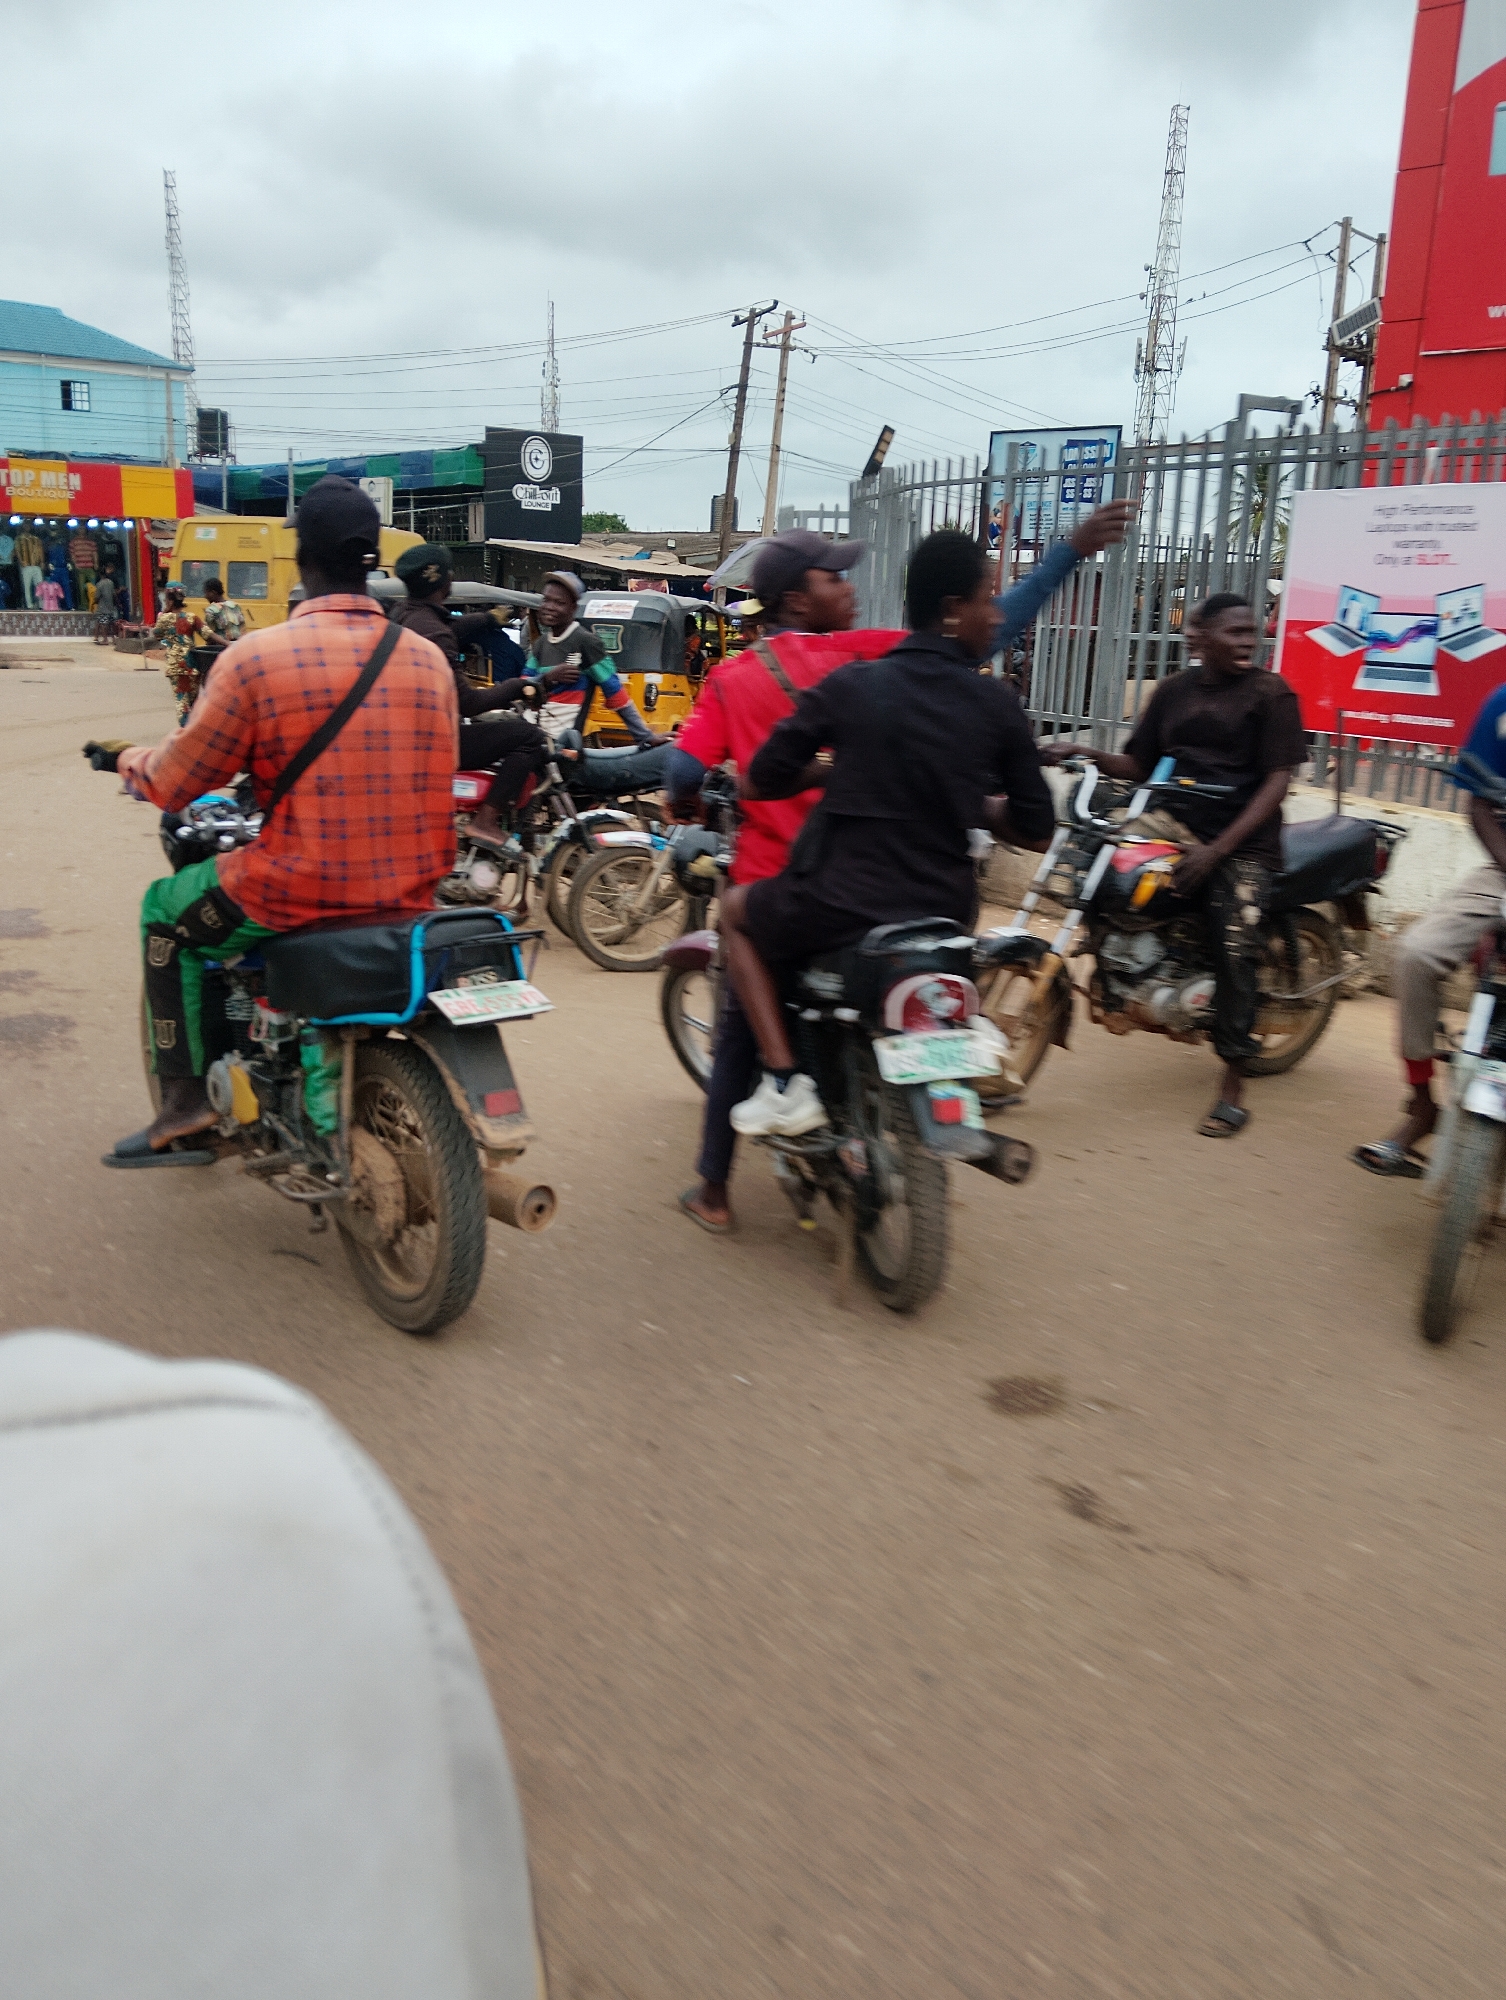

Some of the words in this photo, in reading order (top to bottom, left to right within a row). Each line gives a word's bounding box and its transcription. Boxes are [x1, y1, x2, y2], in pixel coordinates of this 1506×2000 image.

[0, 468, 35, 487] TOP
[40, 470, 81, 490] MEN
[5, 486, 75, 499] BOUTIQUE
[524, 500, 550, 508] LOUNGE
[1373, 553, 1399, 568] Only
